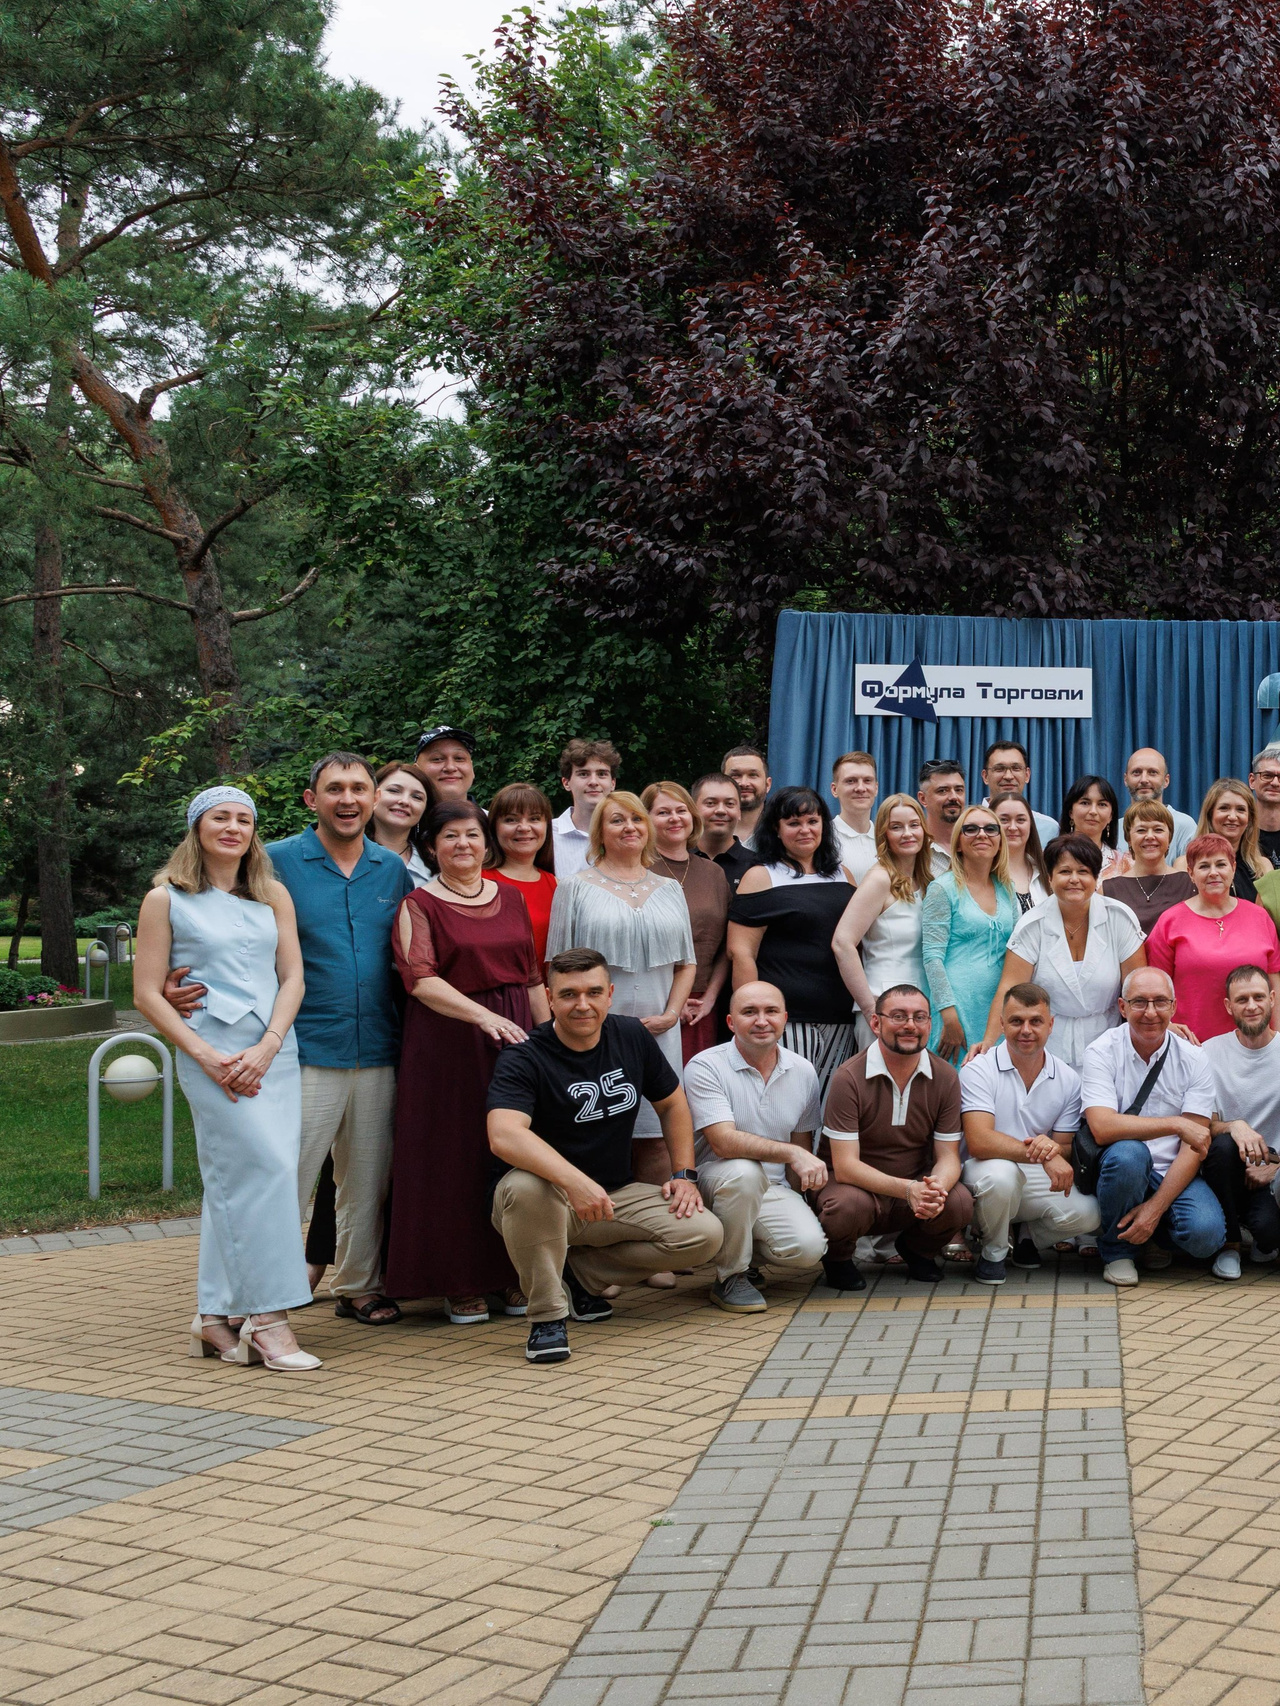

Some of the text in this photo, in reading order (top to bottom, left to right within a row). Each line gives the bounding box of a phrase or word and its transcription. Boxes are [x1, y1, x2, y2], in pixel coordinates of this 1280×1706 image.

[861, 680, 1084, 704] Формула Торговли
[567, 1068, 638, 1123] 25
